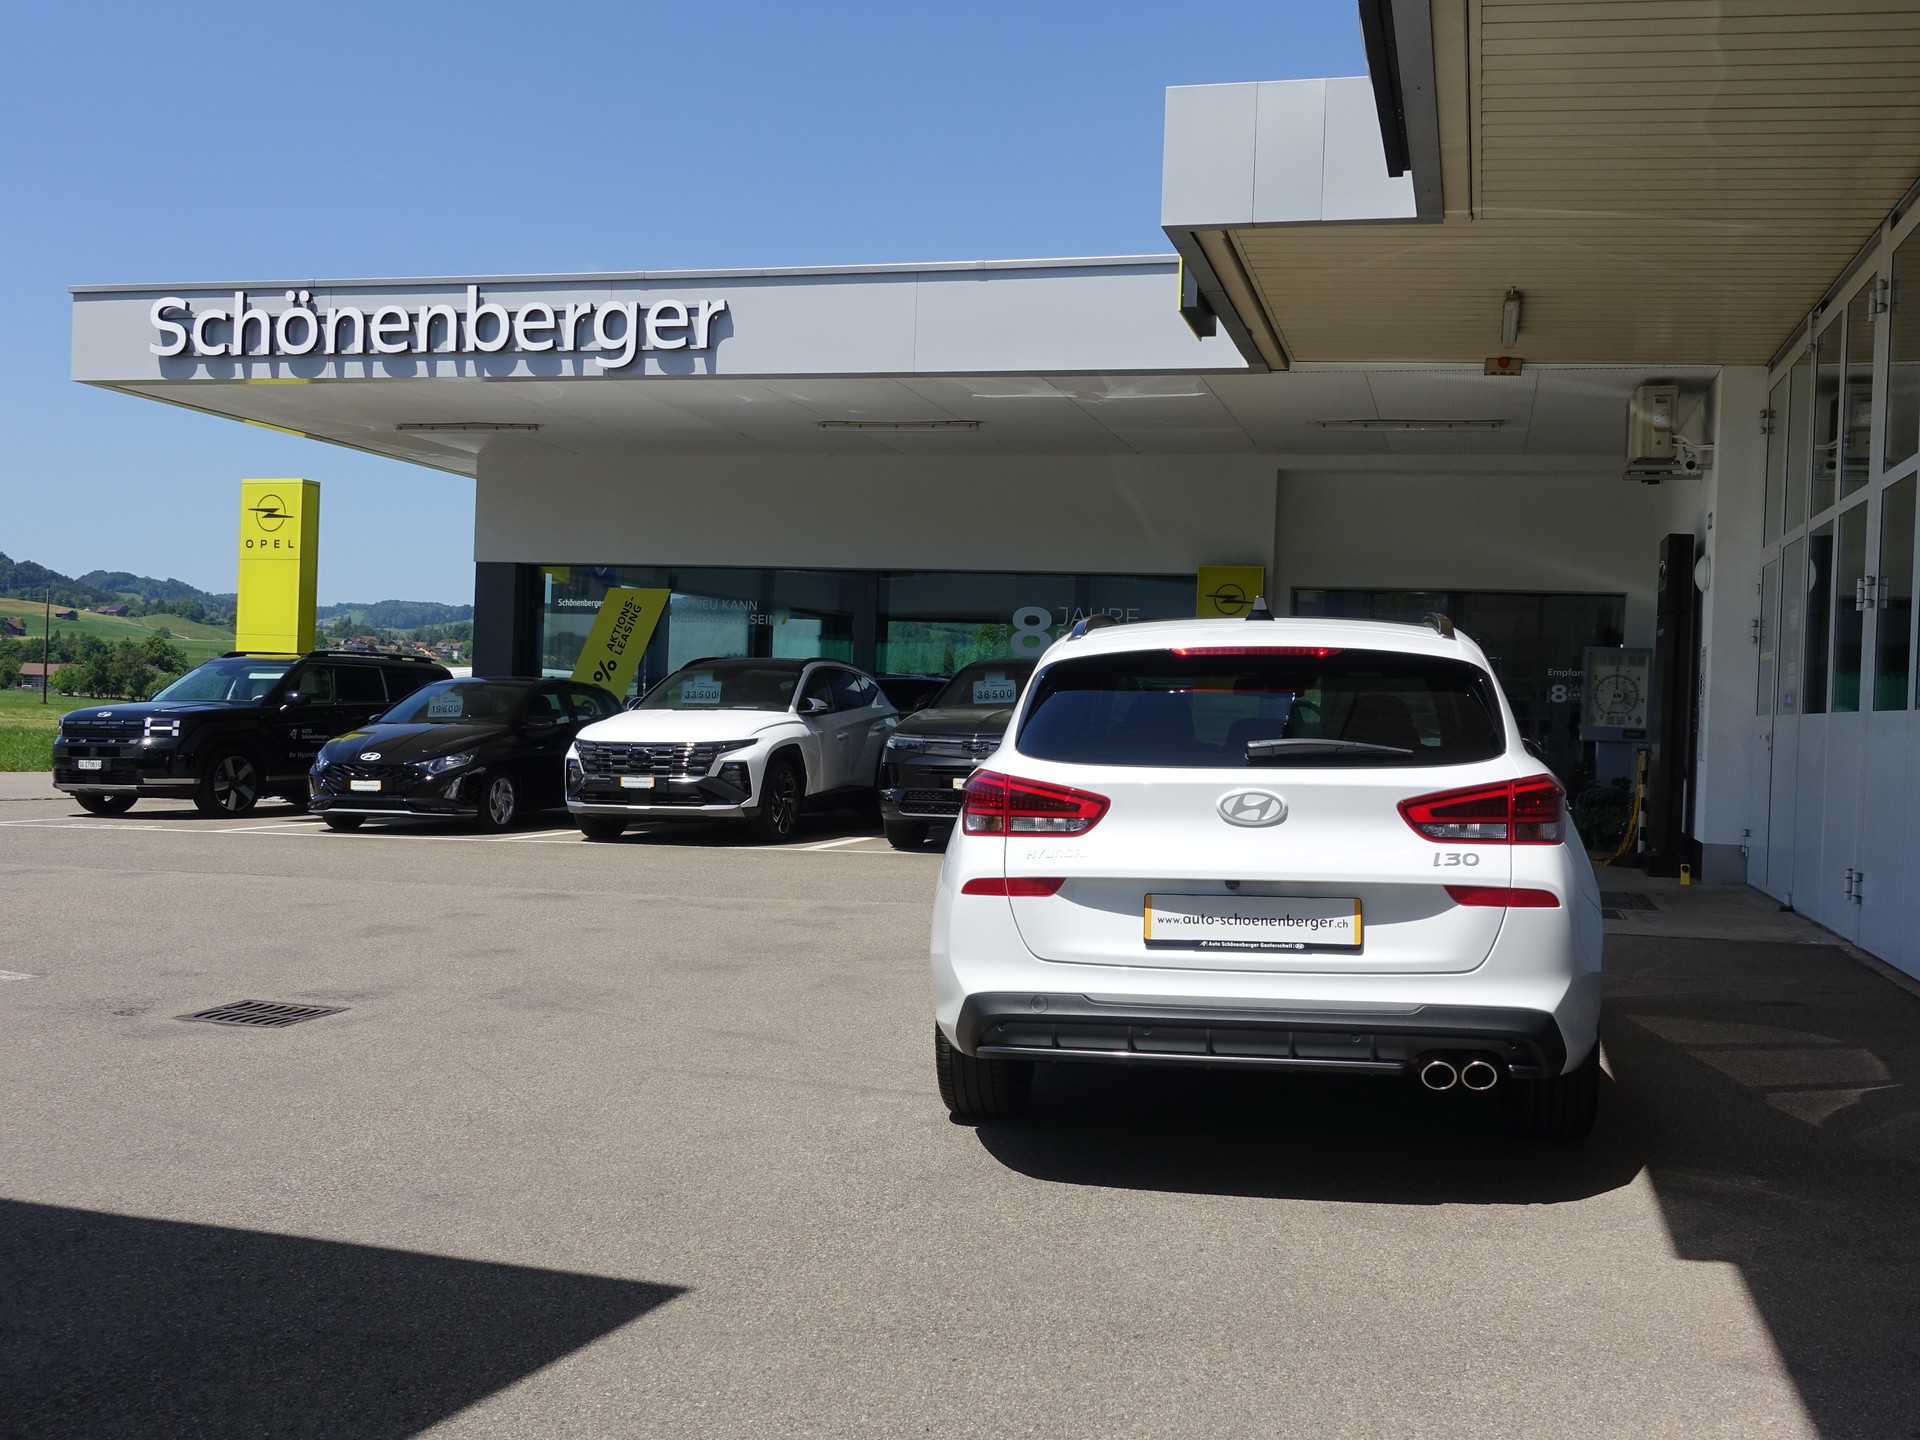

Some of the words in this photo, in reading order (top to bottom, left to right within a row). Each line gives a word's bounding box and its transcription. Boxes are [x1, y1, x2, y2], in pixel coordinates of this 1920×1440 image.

[149, 285, 727, 368] Schönenberger
[245, 539, 294, 549] OPEL
[558, 599, 604, 608] Schönenberge
[693, 600, 718, 610] NEU
[722, 600, 758, 611] KANN
[606, 596, 634, 652] AKTIONS-
[750, 614, 778, 625] SEIN
[614, 604, 642, 656] LEASING
[1010, 606, 1053, 657] 8
[684, 690, 718, 699] 33500
[977, 690, 1013, 699] 38500
[1551, 684, 1568, 703] 8
[431, 704, 460, 713] 19600
[1157, 913, 1349, 931] www.auto-schoenenberger.ch
[1221, 941, 1259, 949] Schönenberger
